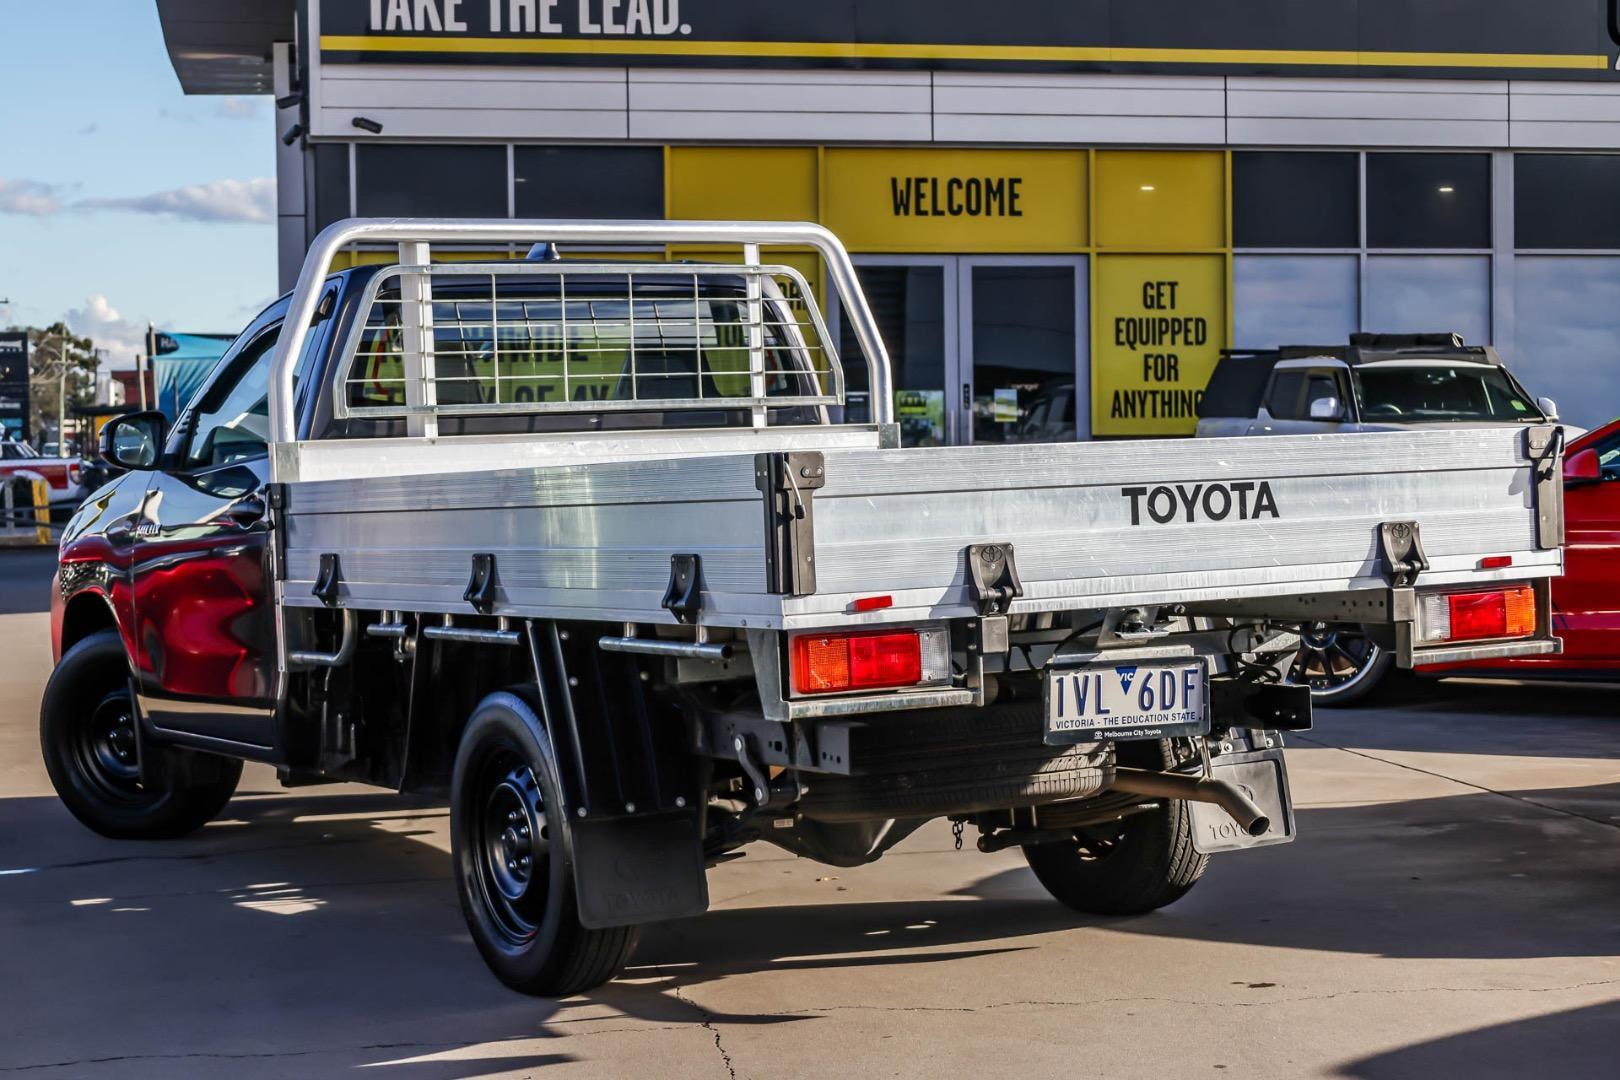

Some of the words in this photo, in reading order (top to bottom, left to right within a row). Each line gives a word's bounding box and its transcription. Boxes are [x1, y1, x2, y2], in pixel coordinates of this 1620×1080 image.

[890, 177, 1023, 217] WELCOME
[1142, 281, 1179, 310] GET
[1114, 317, 1207, 351] EQUIPPED
[1143, 353, 1179, 382] FOR
[1121, 481, 1280, 525] TOYOTA
[1118, 671, 1135, 682] VIC
[1055, 673, 1111, 718] 1VL
[1138, 669, 1199, 712] 6DF
[1055, 717, 1095, 730] VICTORIA
[1103, 717, 1120, 726] THE
[1121, 713, 1169, 725] EDUCATION
[1171, 711, 1196, 722] STATE
[1103, 730, 1133, 738] Melbourne
[1133, 729, 1144, 737] City
